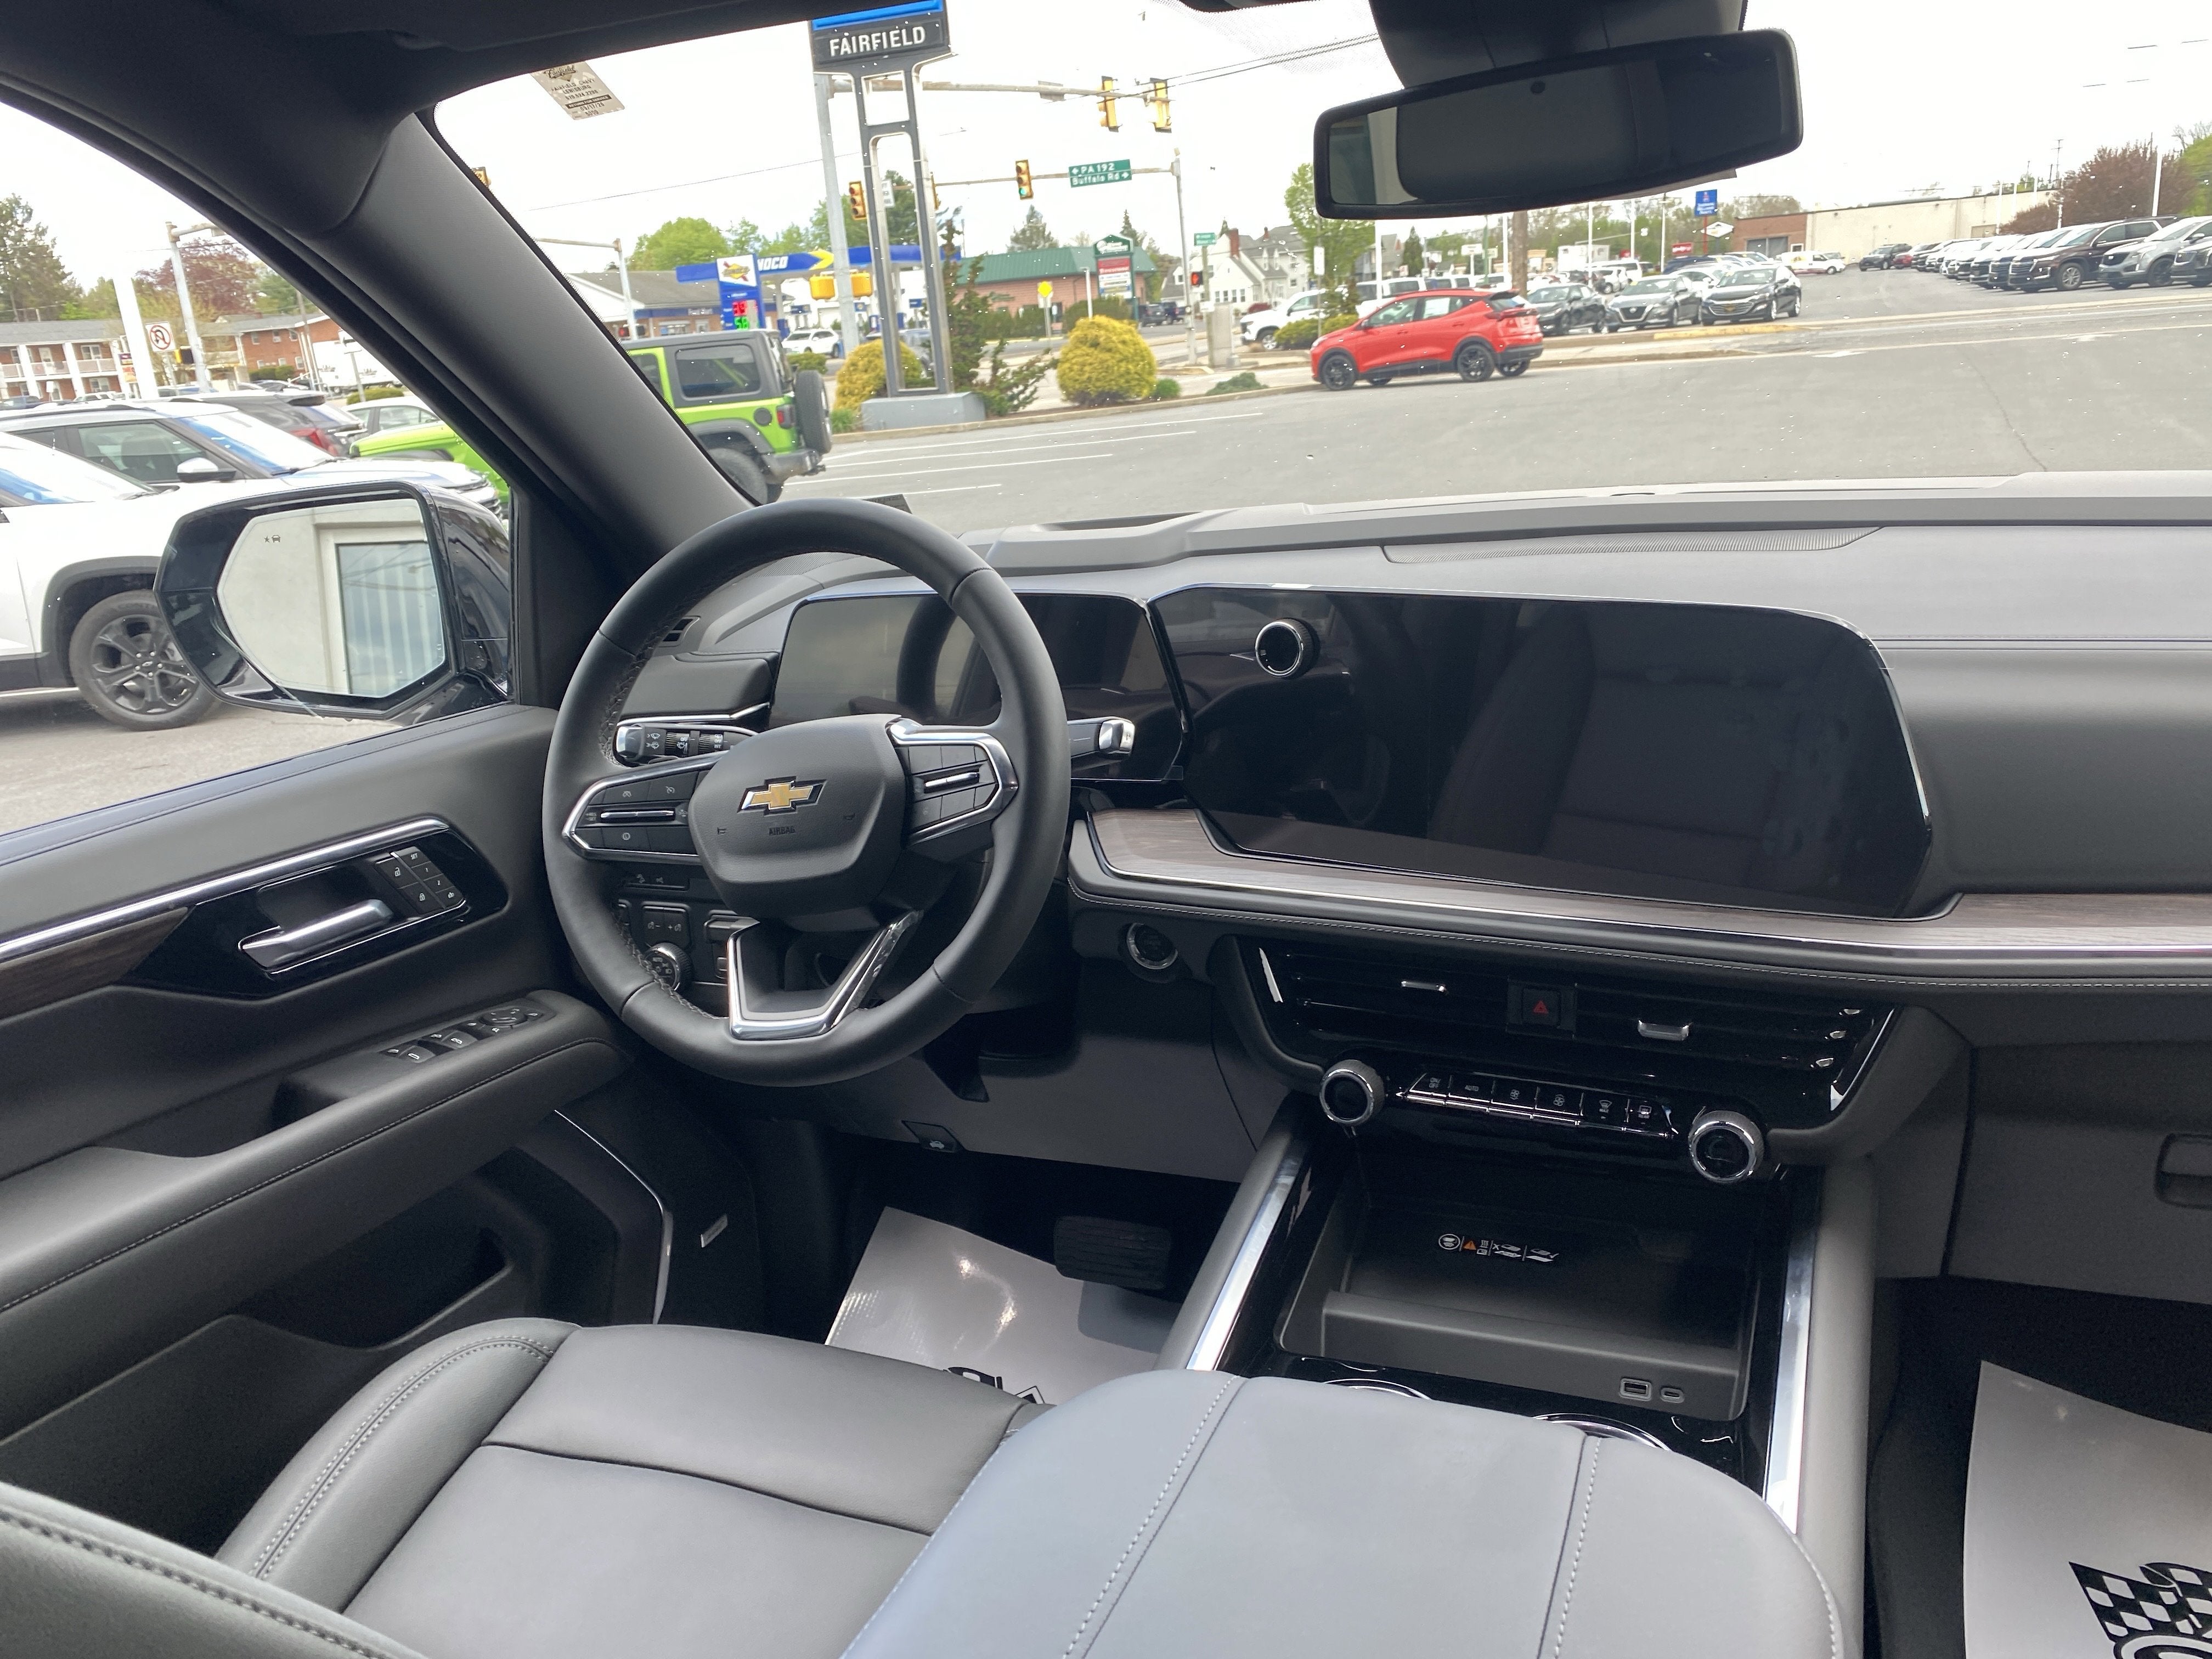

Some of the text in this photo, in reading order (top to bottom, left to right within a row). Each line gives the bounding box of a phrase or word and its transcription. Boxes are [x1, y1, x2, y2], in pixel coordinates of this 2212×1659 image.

[829, 26, 926, 57] FAIRFIELD
[1081, 162, 1115, 174] PA 192
[1072, 172, 1120, 185] Buffalo Rd
[757, 256, 789, 271] NOCO
[769, 826, 795, 836] AIRBAG
